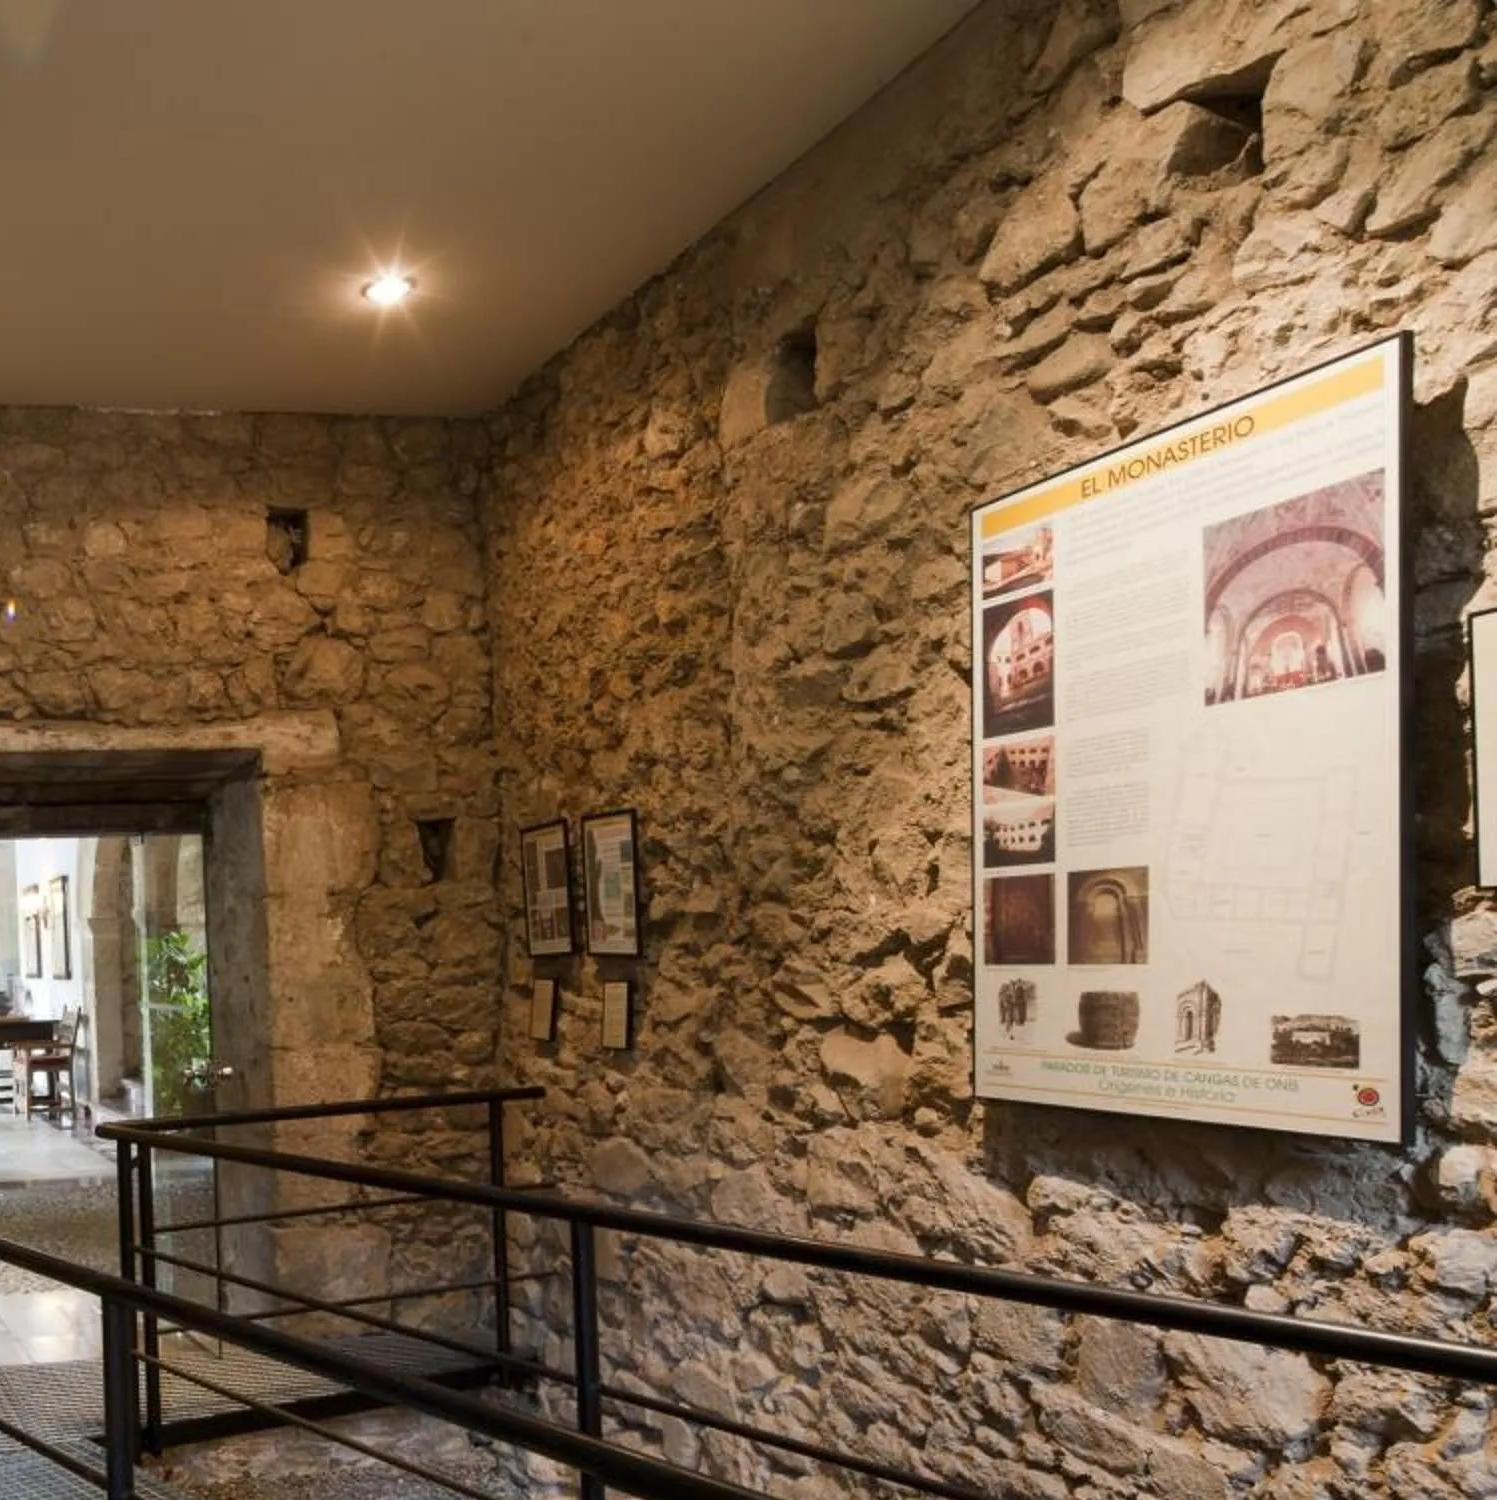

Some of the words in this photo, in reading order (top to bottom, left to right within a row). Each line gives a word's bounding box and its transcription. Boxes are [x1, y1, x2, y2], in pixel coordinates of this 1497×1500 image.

[1080, 476, 1103, 498] EL
[1107, 415, 1256, 489] MONASTERIO
[1164, 1070, 1180, 1082] DE
[1185, 1071, 1239, 1087] CANGAS
[1243, 1075, 1261, 1089] DE
